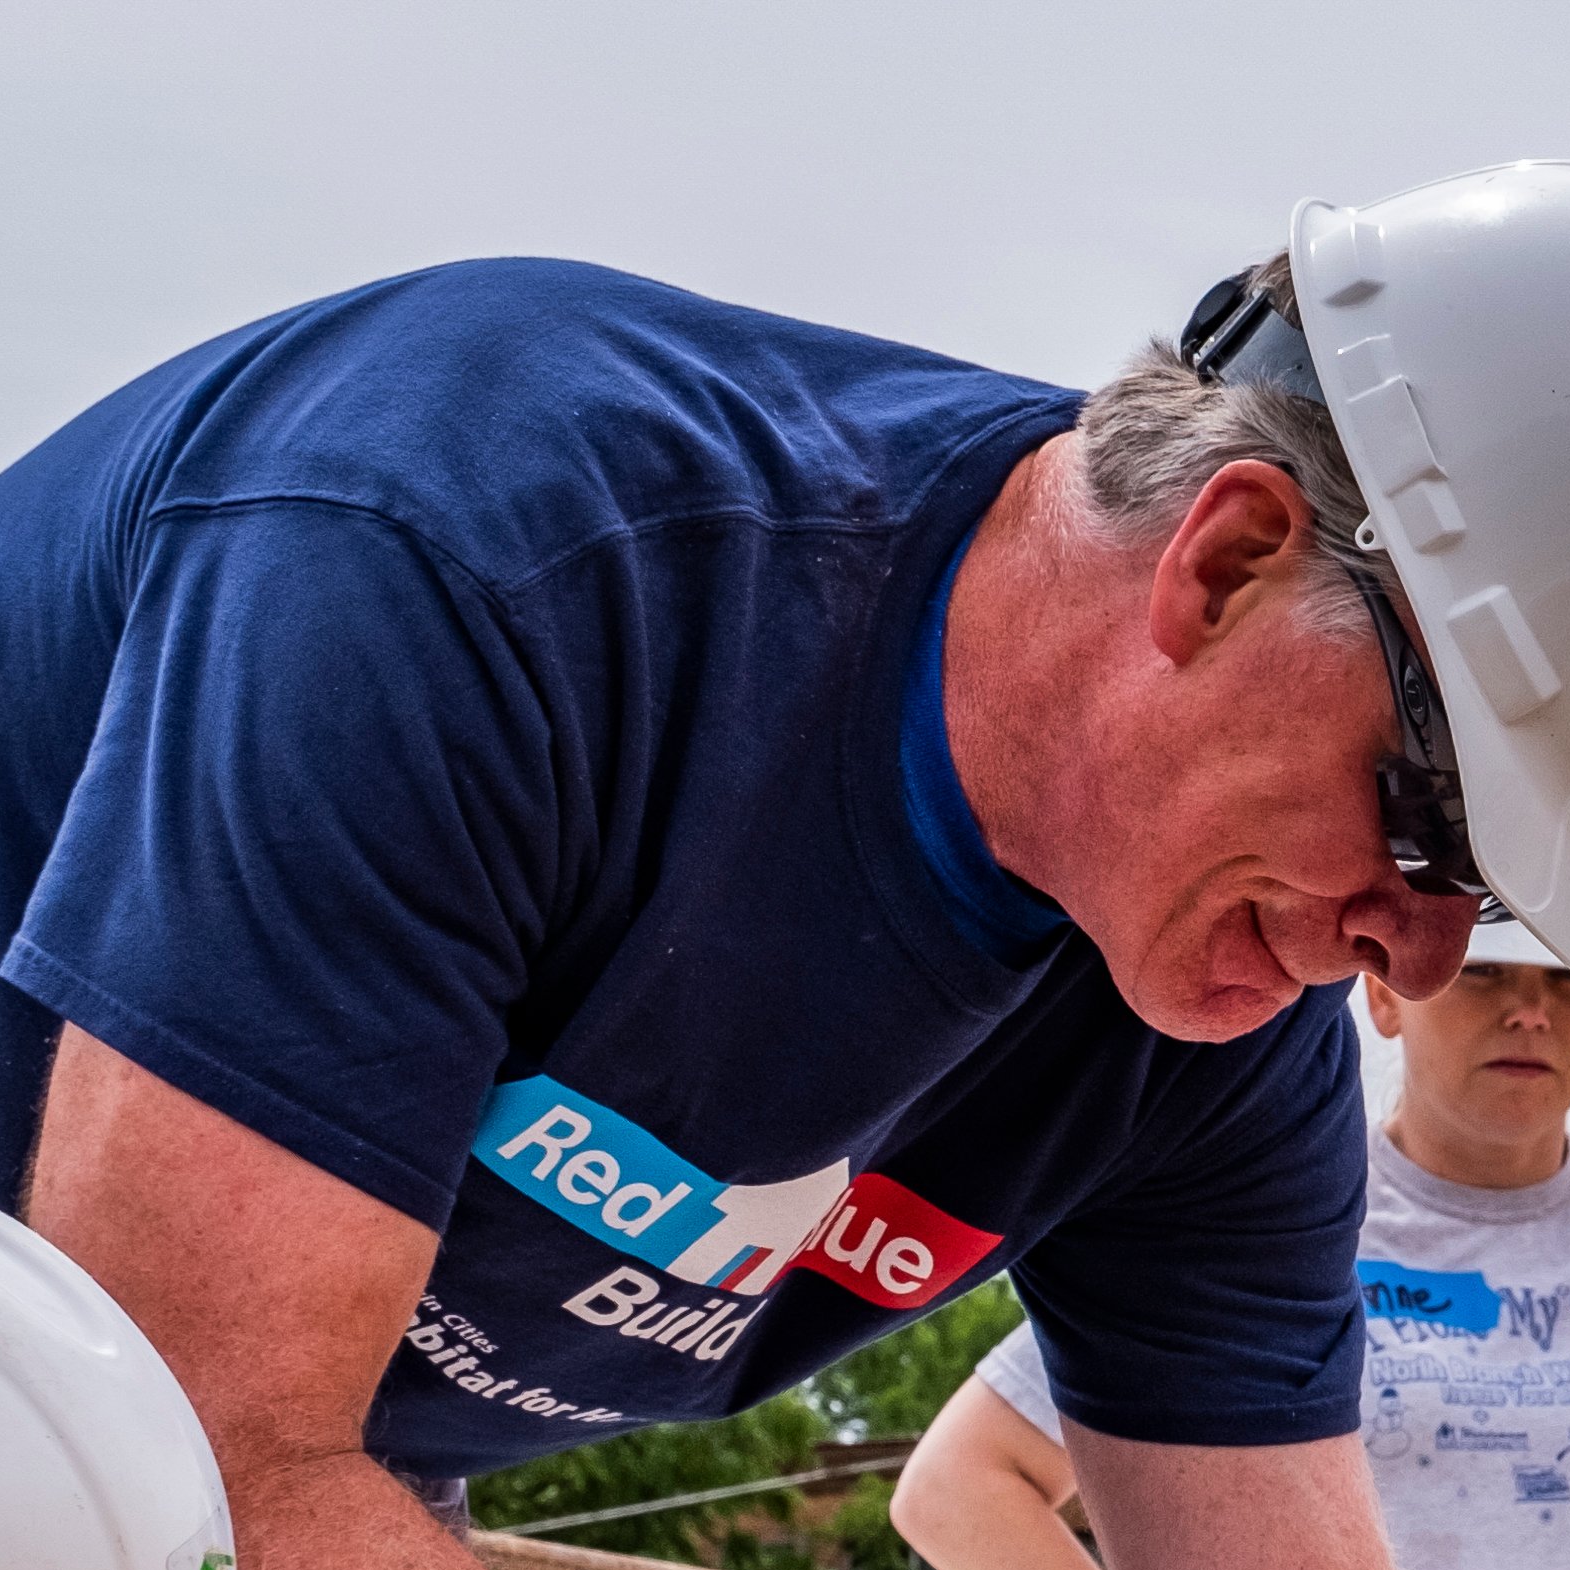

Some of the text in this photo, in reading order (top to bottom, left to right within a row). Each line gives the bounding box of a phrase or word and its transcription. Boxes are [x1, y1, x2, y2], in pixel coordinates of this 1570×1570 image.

[497, 1103, 934, 1295] Red lue
[420, 1293, 499, 1353] in Cities
[561, 1266, 768, 1361] Build
[1499, 1287, 1559, 1352] My
[406, 1314, 578, 1417] bitat for
